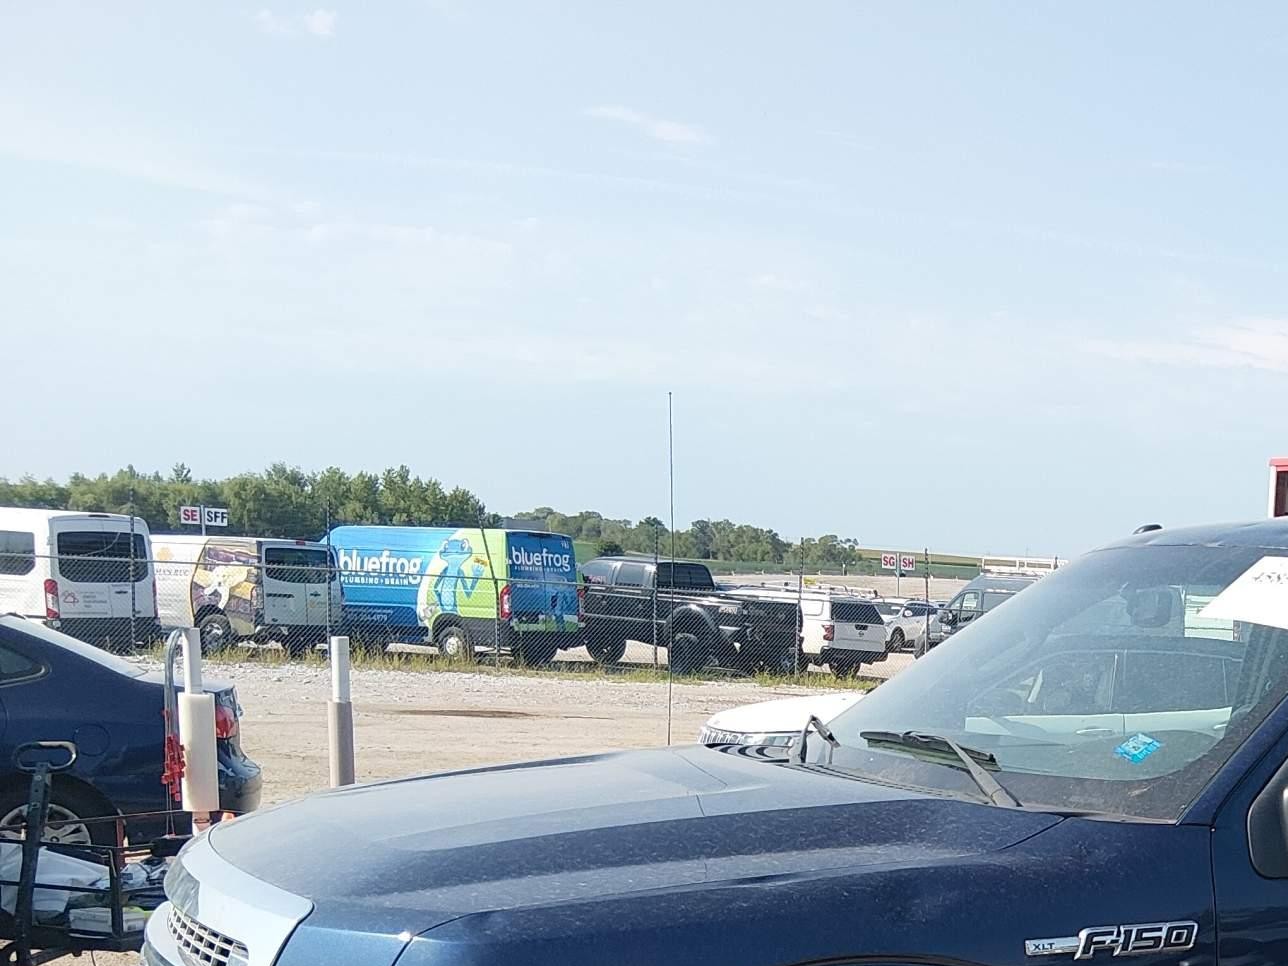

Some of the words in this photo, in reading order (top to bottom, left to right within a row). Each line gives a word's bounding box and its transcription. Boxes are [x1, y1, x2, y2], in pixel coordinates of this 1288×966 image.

[183, 509, 198, 521] SE
[206, 510, 228, 523] SFF
[511, 546, 571, 572] bluefrog
[882, 555, 896, 567] SG
[902, 557, 914, 568] SH
[339, 547, 423, 584] bluefrog
[340, 575, 379, 584] PLUMBING
[1032, 942, 1055, 951] XLT
[1073, 920, 1199, 960] F-150
